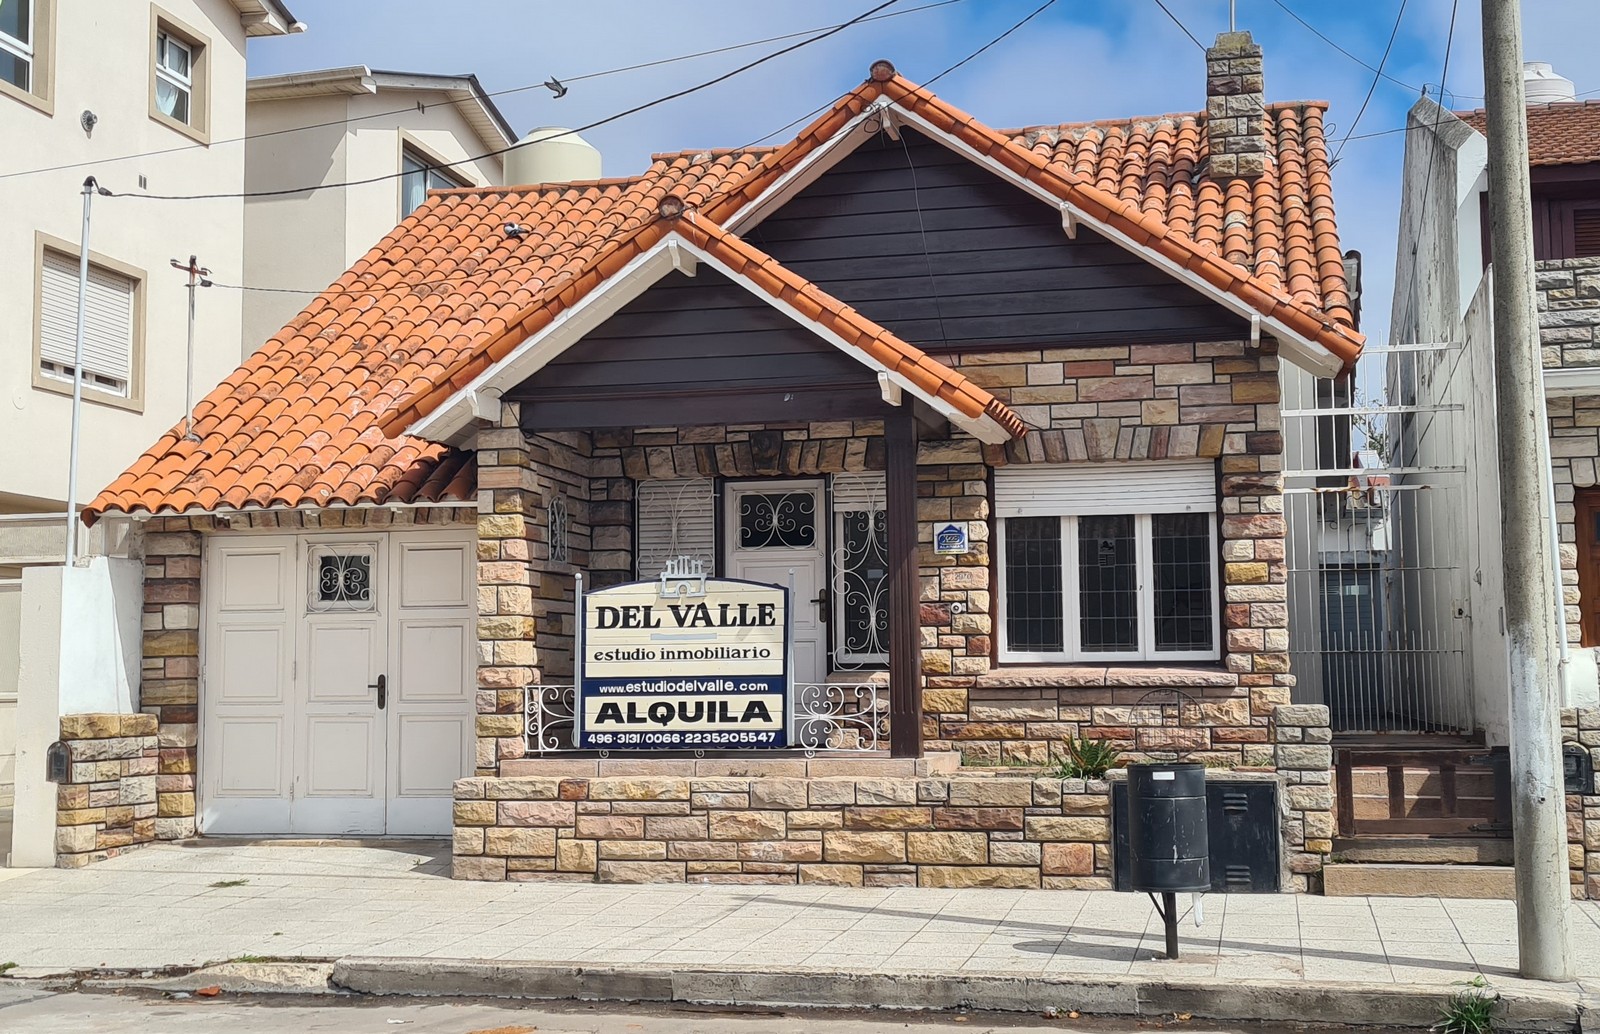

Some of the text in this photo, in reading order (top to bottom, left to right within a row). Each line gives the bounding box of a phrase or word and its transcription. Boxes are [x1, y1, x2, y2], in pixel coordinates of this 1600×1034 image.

[595, 603, 776, 629] DEL VALLE
[594, 647, 771, 661] estudio inmobiliario
[594, 701, 773, 726] ALQUILA
